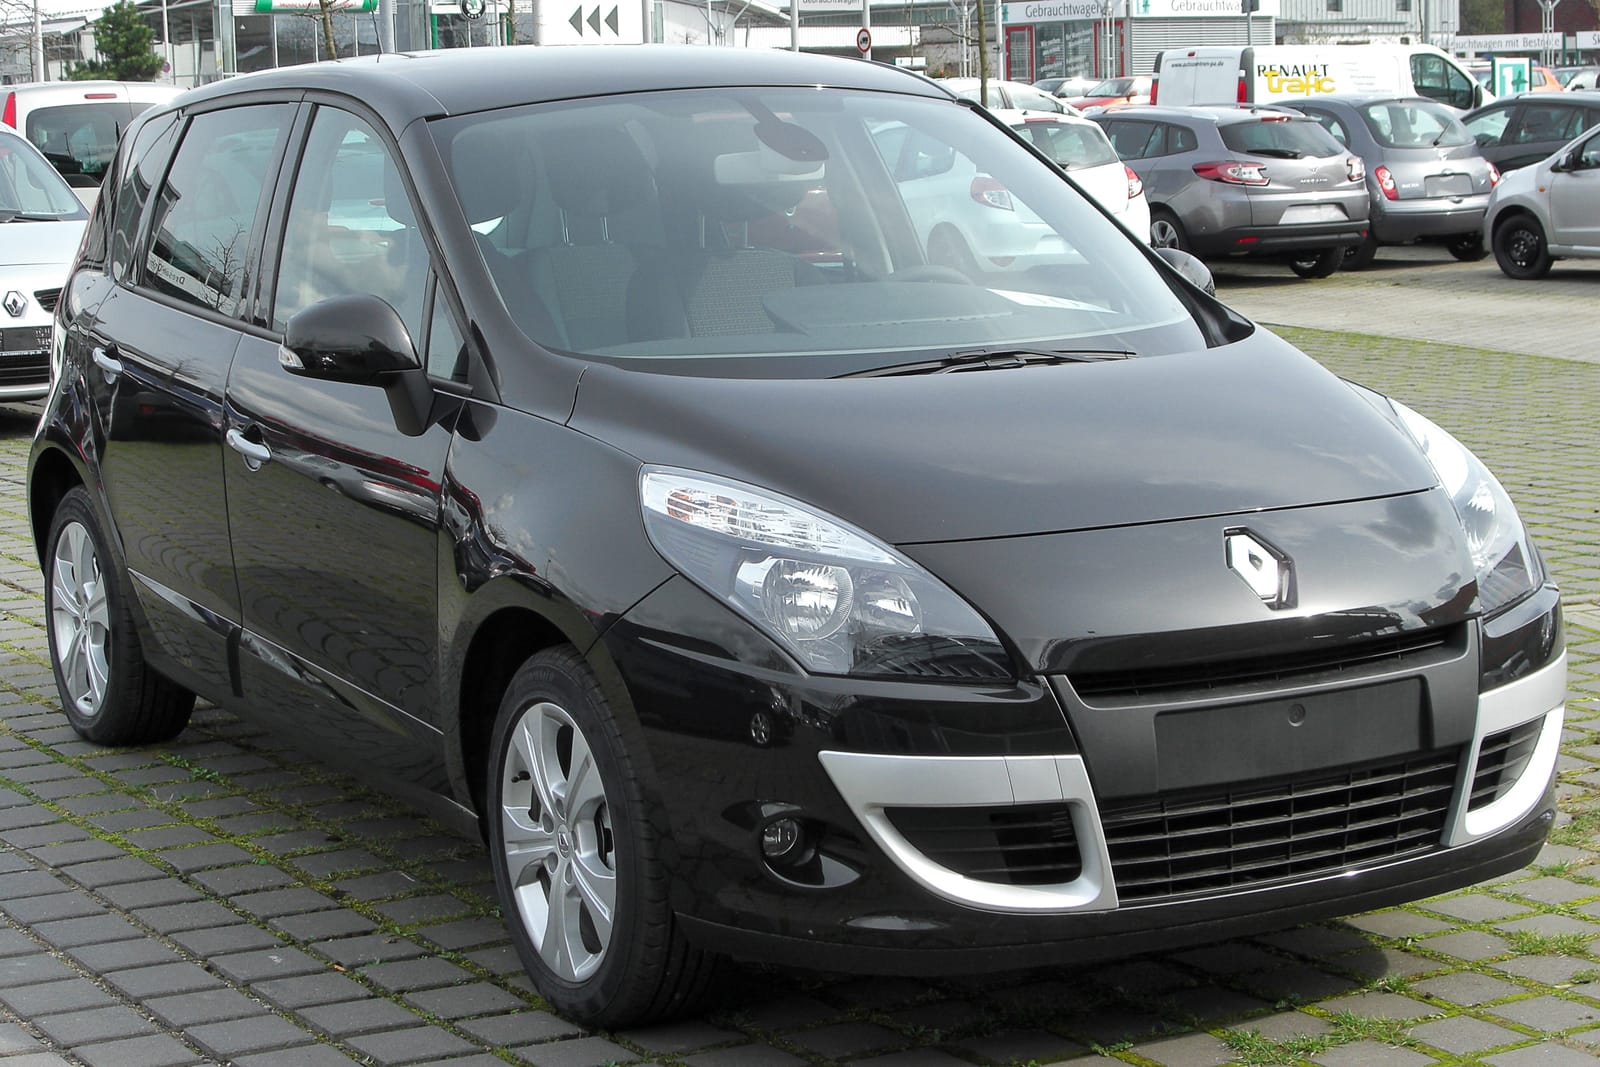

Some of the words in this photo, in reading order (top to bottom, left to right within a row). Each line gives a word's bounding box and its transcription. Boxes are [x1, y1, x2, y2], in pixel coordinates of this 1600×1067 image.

[1170, 0, 1241, 12] Gebrauchtwa
[1505, 39, 1519, 48] mit
[1522, 37, 1560, 48] Bestnoe
[1257, 64, 1329, 77] RENAULT
